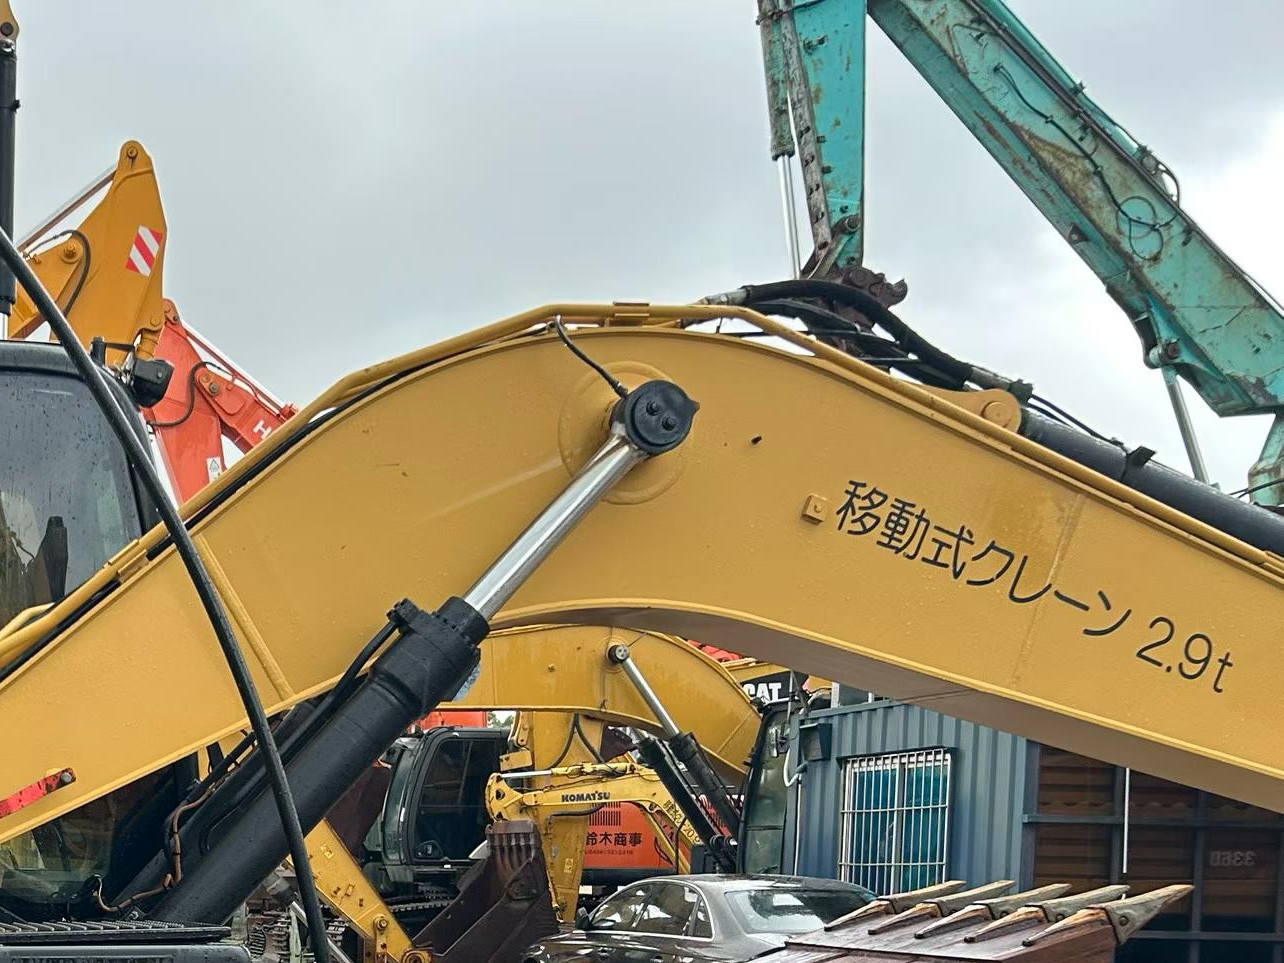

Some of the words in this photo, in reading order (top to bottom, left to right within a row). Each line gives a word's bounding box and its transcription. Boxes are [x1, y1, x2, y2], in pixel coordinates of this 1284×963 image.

[835, 479, 1133, 637] 移動式クレーン
[1136, 616, 1234, 694] 2.9t
[741, 682, 782, 704] CAT
[561, 791, 611, 803] KOMATSU
